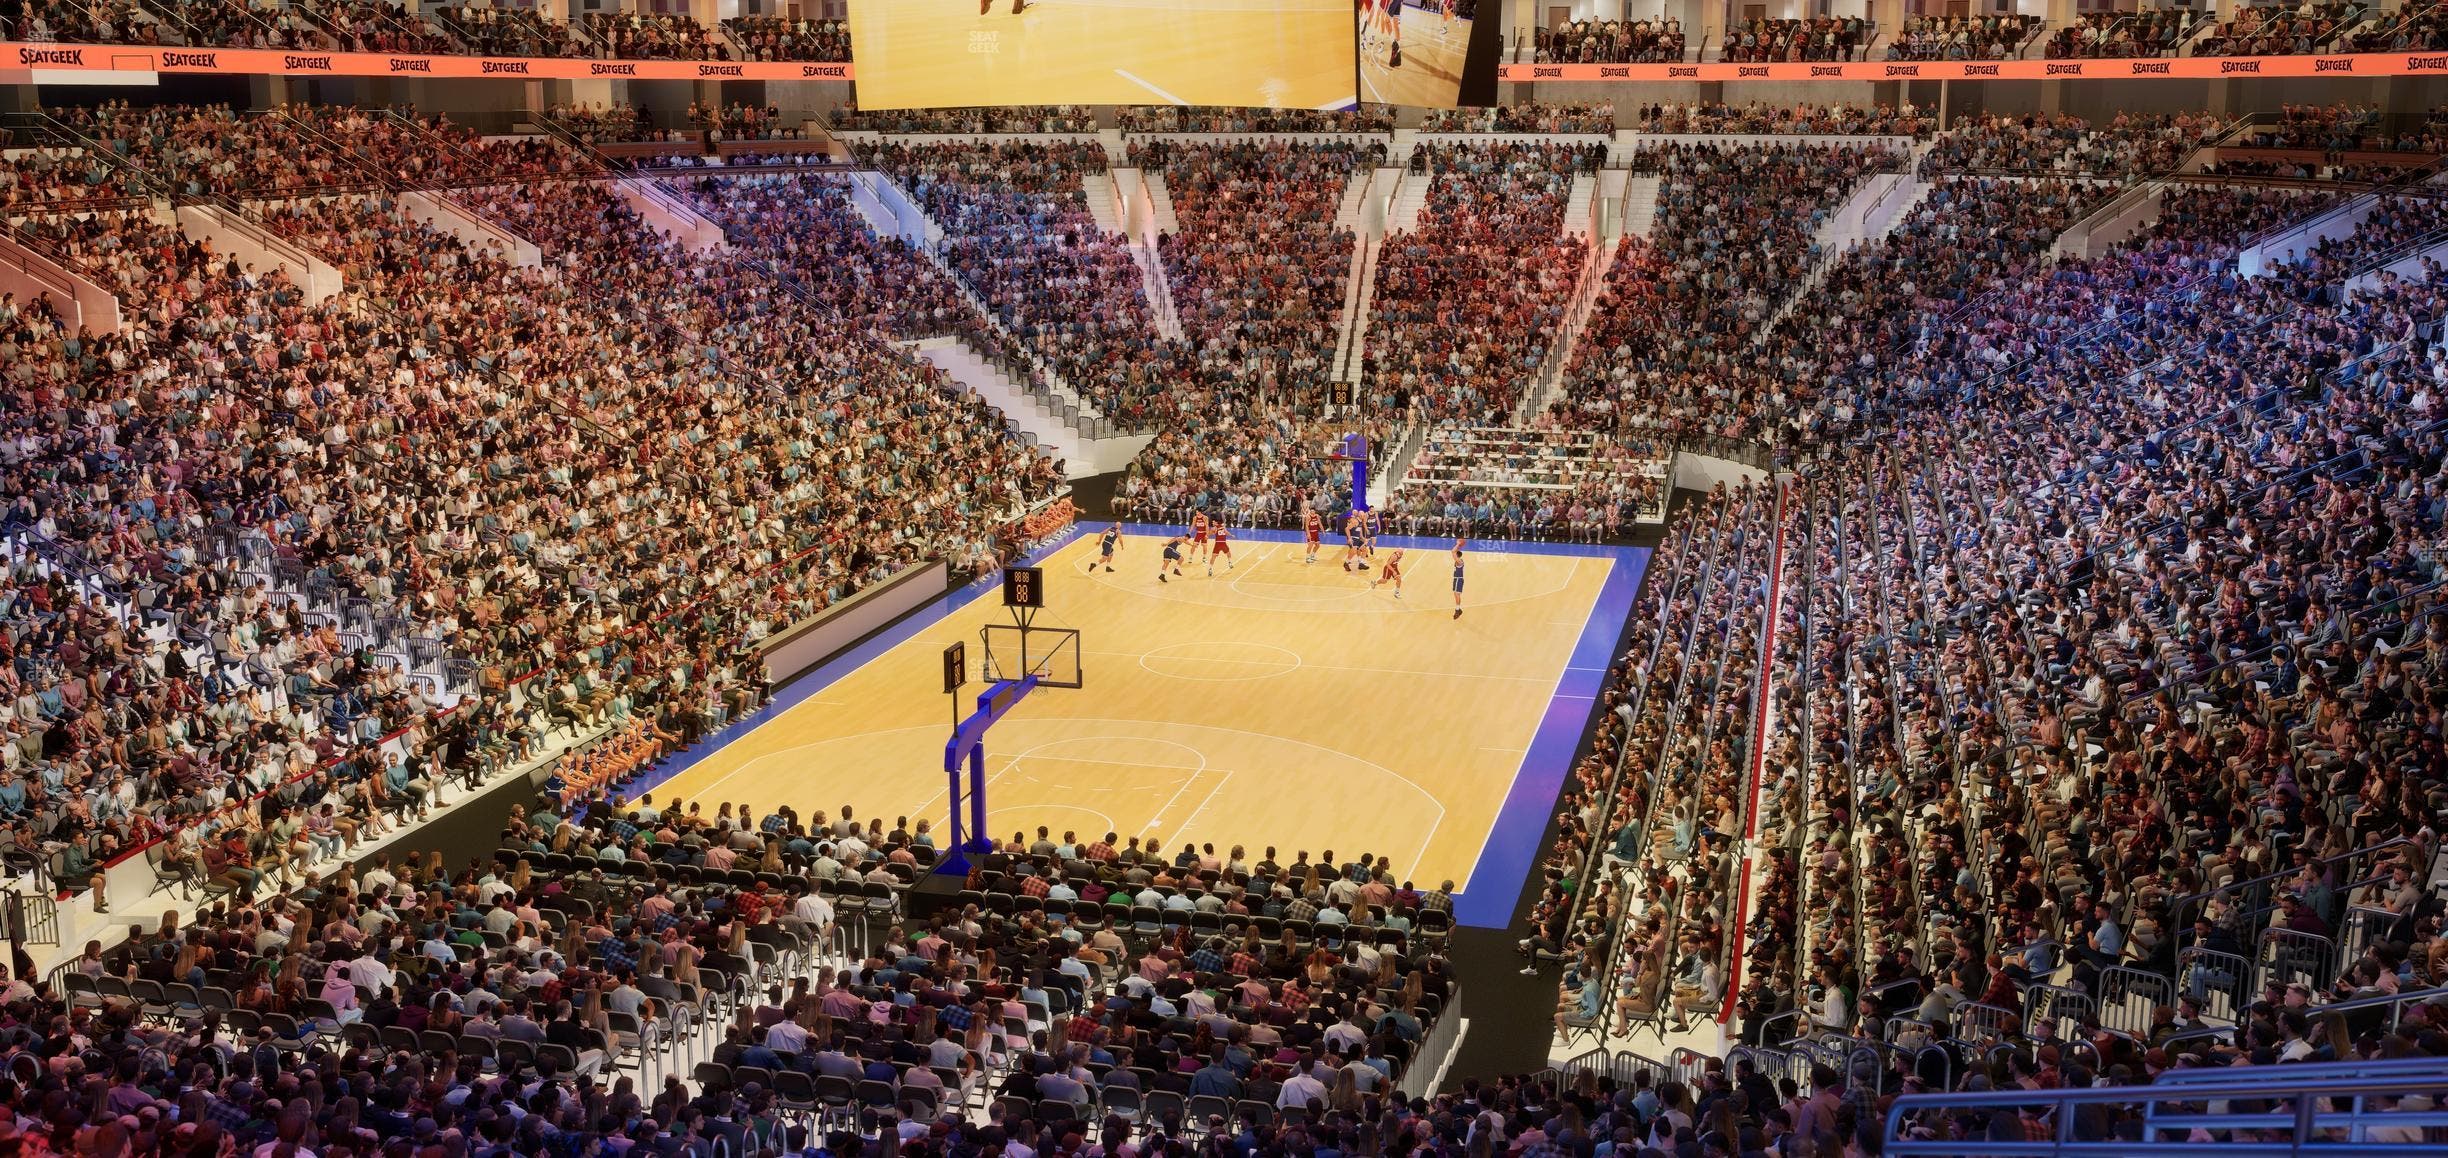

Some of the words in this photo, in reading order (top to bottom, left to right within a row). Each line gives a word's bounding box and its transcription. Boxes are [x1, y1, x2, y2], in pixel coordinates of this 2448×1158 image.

[20, 48, 83, 66] SEATGEEK
[163, 52, 217, 68] SEATGEEK
[285, 56, 331, 71] SEATGEEK
[391, 59, 431, 72] SEATGEEK
[482, 61, 528, 74] SEATGEEK
[591, 63, 635, 75] SEATGEEK
[699, 65, 743, 76] SEATGEEK
[803, 66, 845, 77] SEATGEEK
[1534, 67, 1562, 77] SEATGEEK
[1601, 67, 1629, 77] SEATGEEK
[1669, 67, 1698, 77] SEATGEEK
[1739, 67, 1769, 77] SEATGEEK
[1811, 66, 1842, 76] SEATGEEK
[1886, 66, 1918, 76] SEATGEEK
[1965, 65, 1998, 75] SEATGEEK
[2047, 64, 2082, 75] SEATGEEK
[2133, 62, 2170, 74] SEATGEEK
[2221, 61, 2260, 73] SEATGEEK
[2315, 59, 2353, 72] SEATGEEK
[2408, 56, 2448, 70] SEATGEEK
